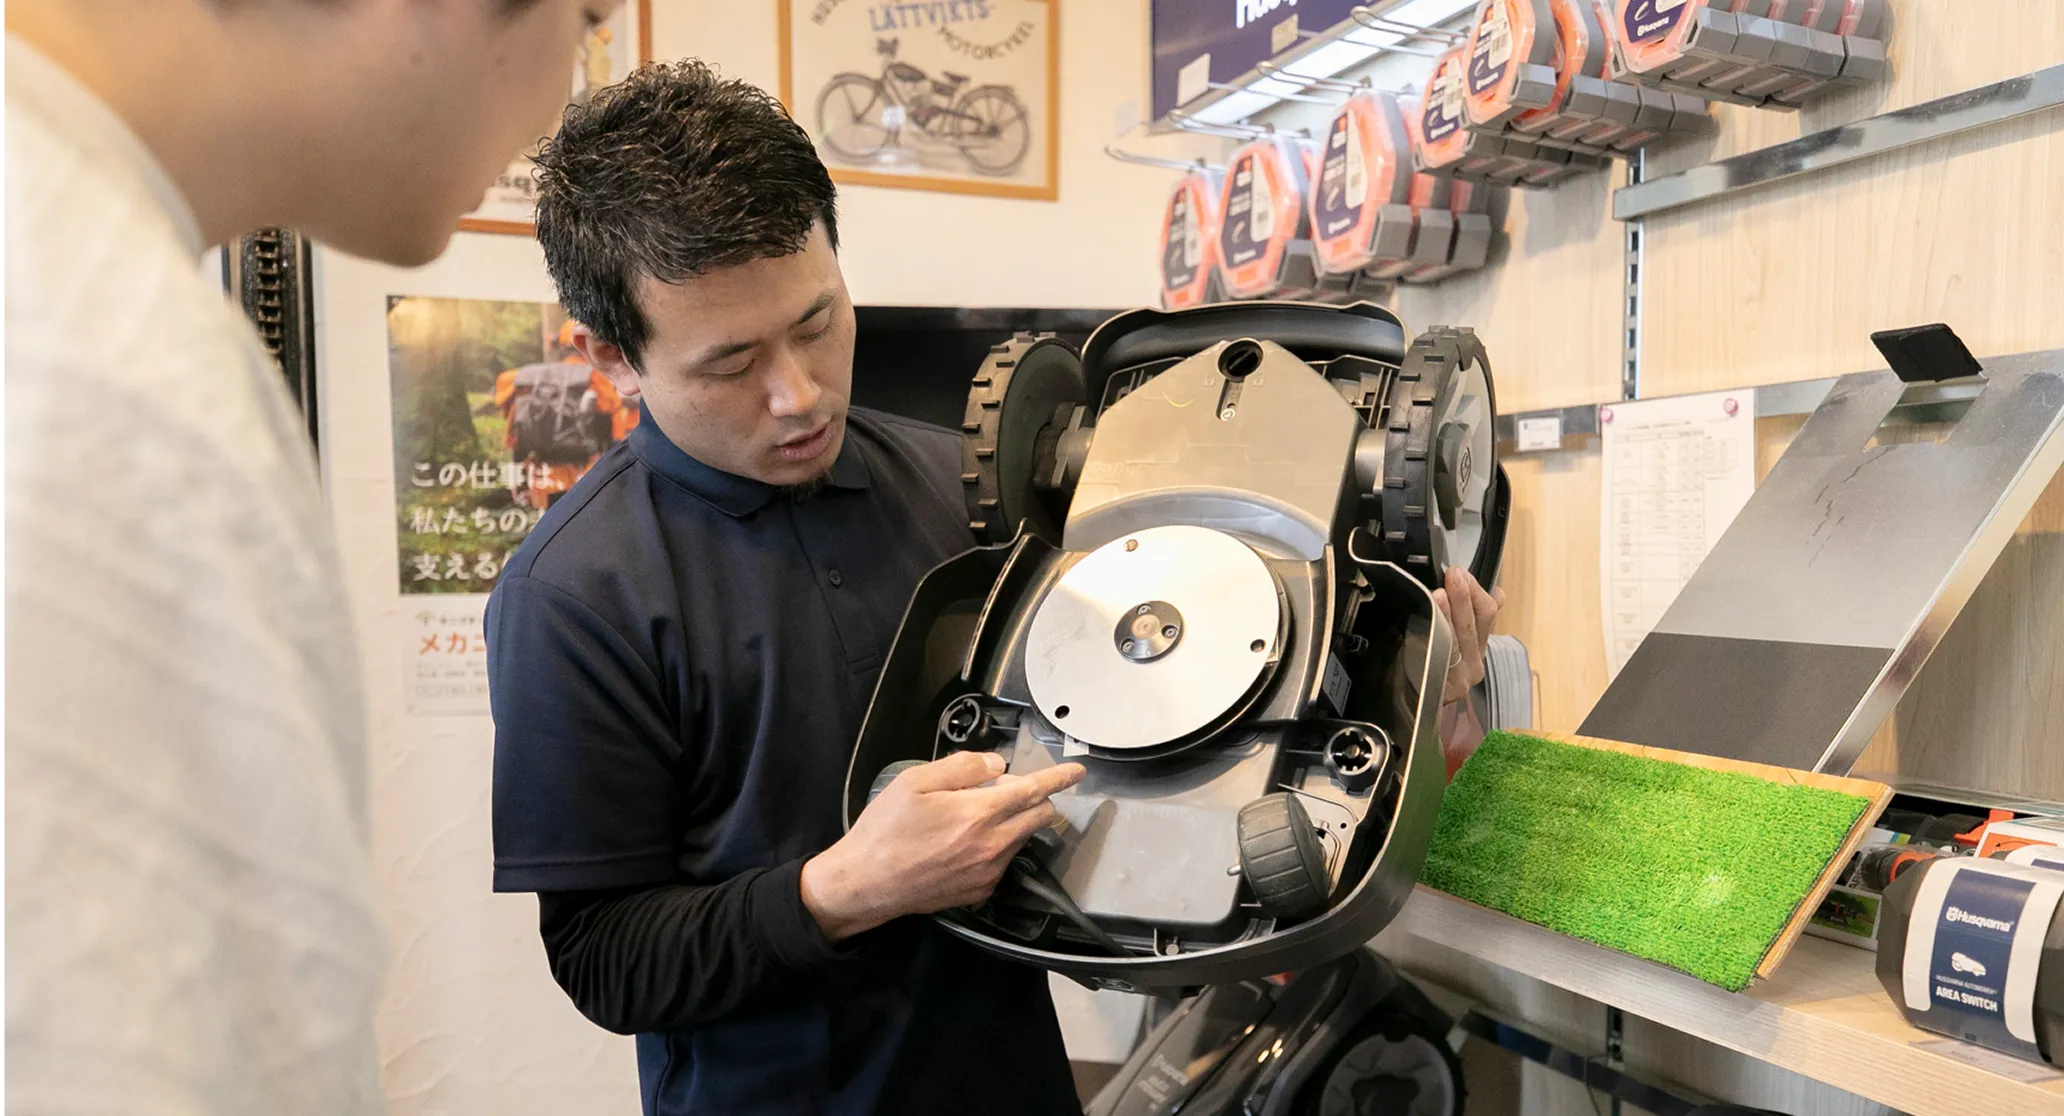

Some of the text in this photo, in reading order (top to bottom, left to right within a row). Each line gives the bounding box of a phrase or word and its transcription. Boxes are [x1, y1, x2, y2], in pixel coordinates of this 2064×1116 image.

[1956, 909, 2011, 933] Husqvarna
[1935, 985, 1999, 1012] AREA SWITCH
